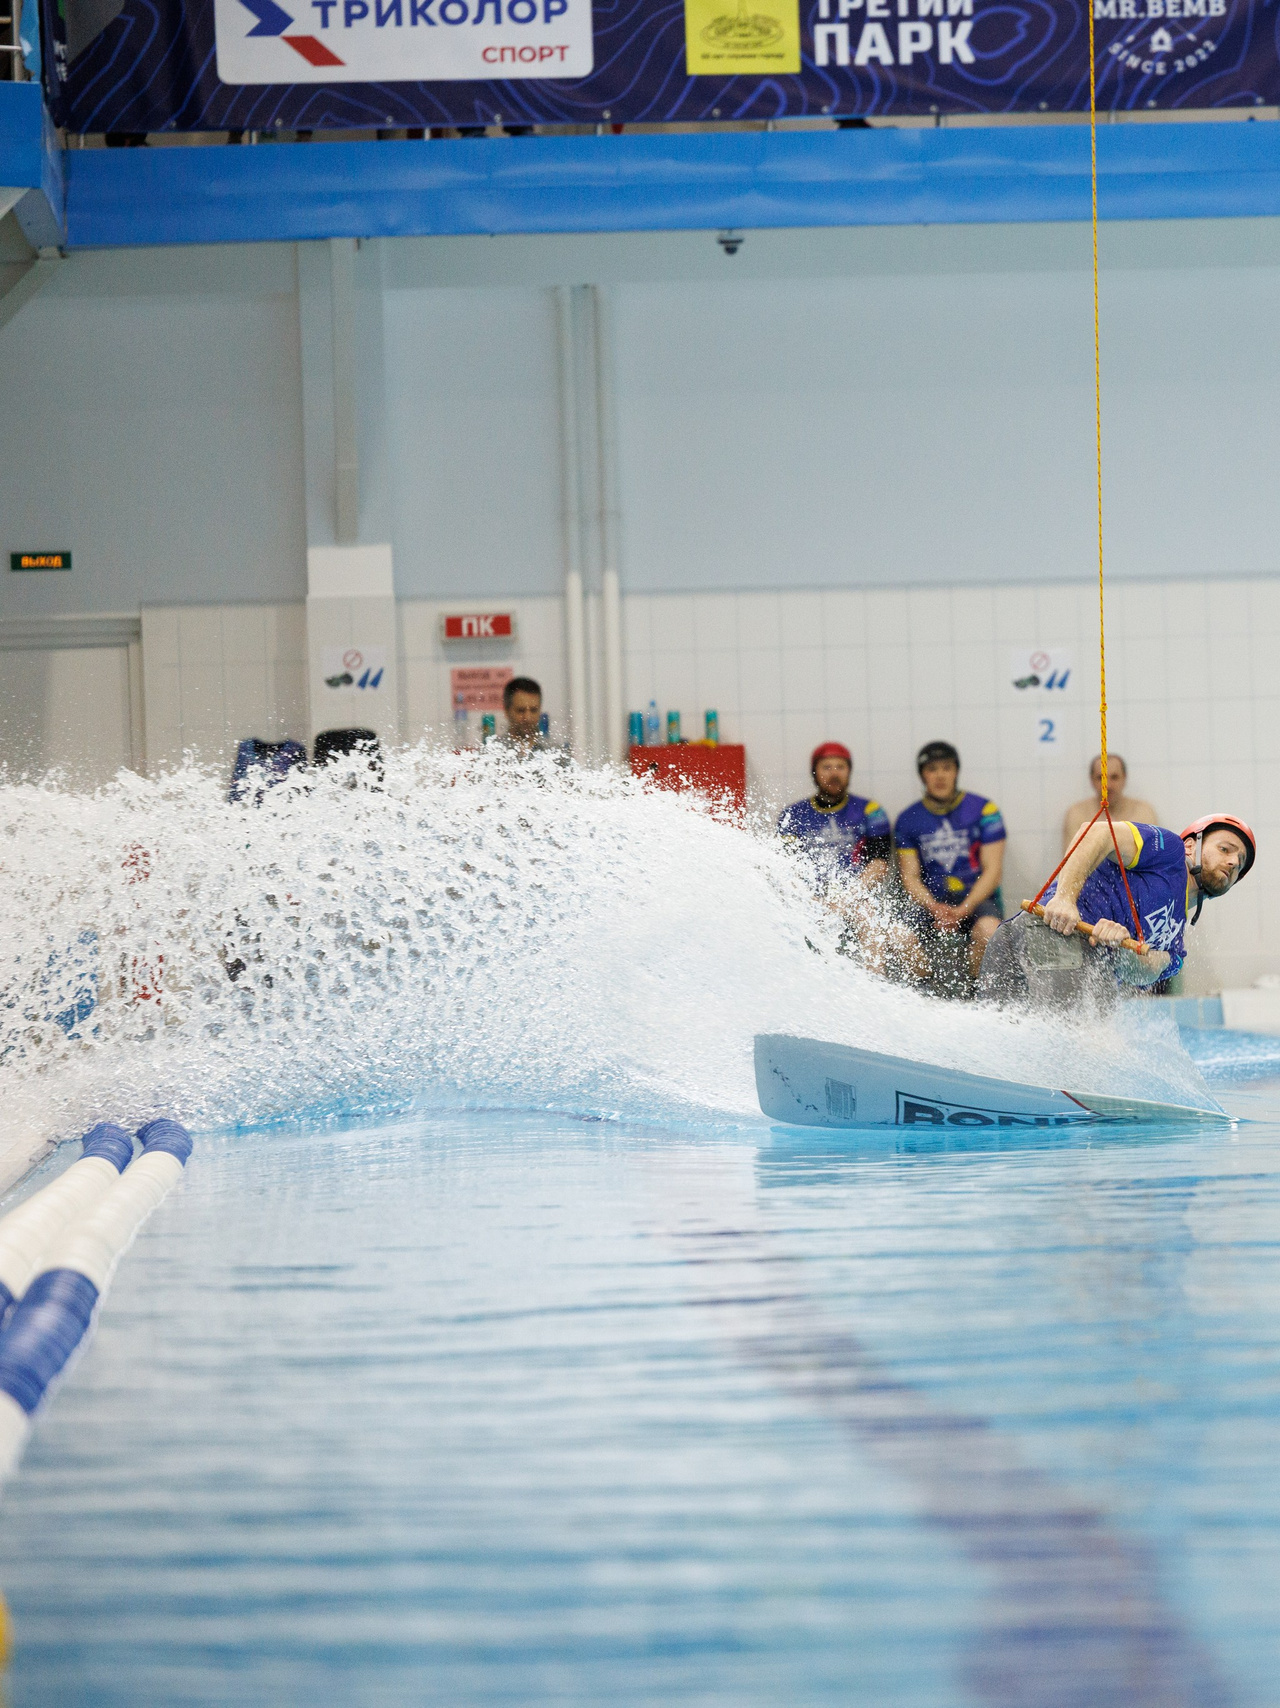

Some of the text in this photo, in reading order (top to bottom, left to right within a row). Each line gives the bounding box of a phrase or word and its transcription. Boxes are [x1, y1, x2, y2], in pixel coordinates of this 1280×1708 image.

[312, 0, 568, 29] ТРИКОЛОР
[482, 45, 569, 64] СПОРТ
[814, 20, 976, 66] ПАРК
[1108, 42, 1168, 75] SINCE
[461, 617, 495, 637] ПК
[1039, 718, 1056, 742] 2
